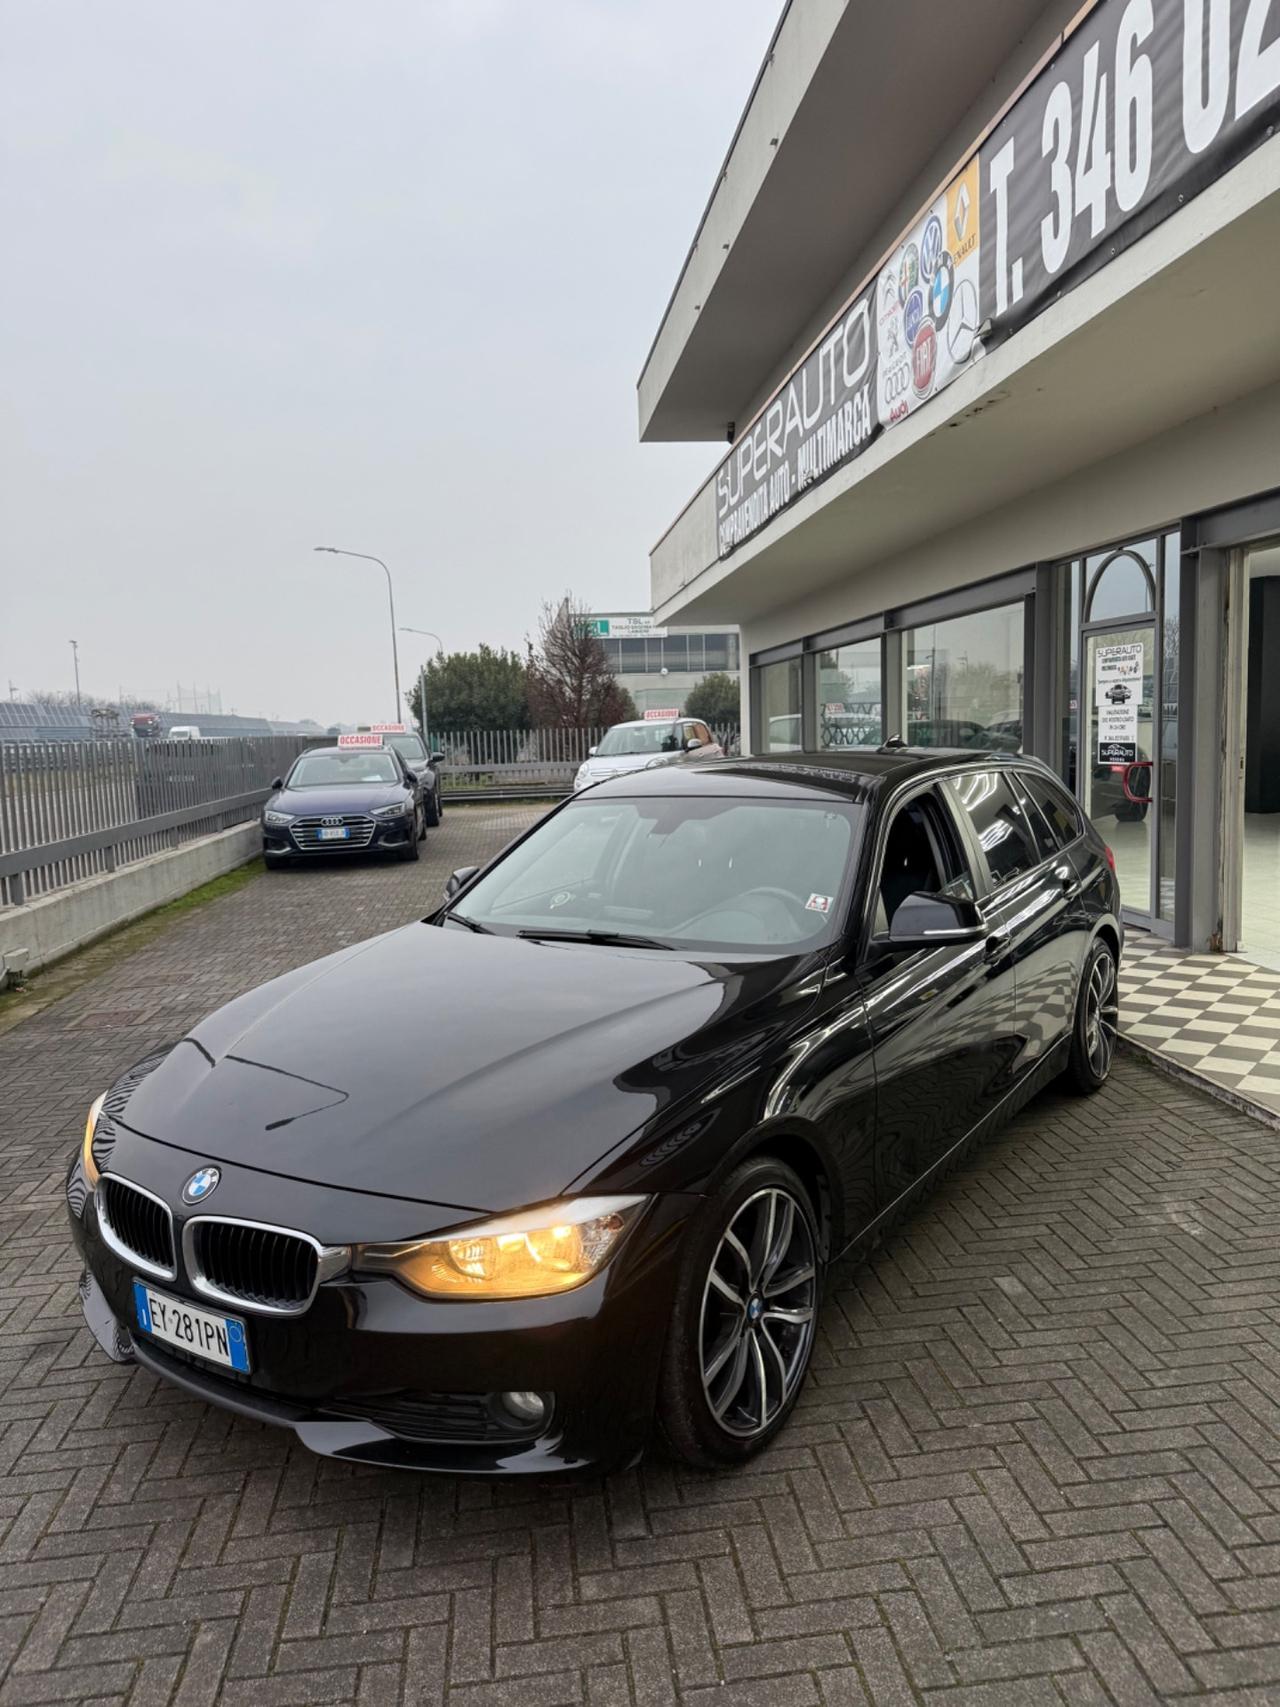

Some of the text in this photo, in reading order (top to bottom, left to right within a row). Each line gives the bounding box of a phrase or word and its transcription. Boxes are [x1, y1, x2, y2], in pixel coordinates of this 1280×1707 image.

[989, 136, 1024, 317] T.
[1041, 0, 1154, 274] 346
[951, 233, 976, 266] ENAULT
[917, 337, 932, 379] FIAT
[718, 298, 870, 518] SUPERAUTO
[770, 460, 790, 516] AUTO
[798, 384, 872, 492] MULTIMARCA
[1097, 644, 1142, 658] SUPERAUTO
[340, 735, 381, 745] OCCASIONE
[372, 724, 405, 732] OCCASIONE
[148, 1297, 168, 1332] EY
[172, 1308, 230, 1358] 281PN
